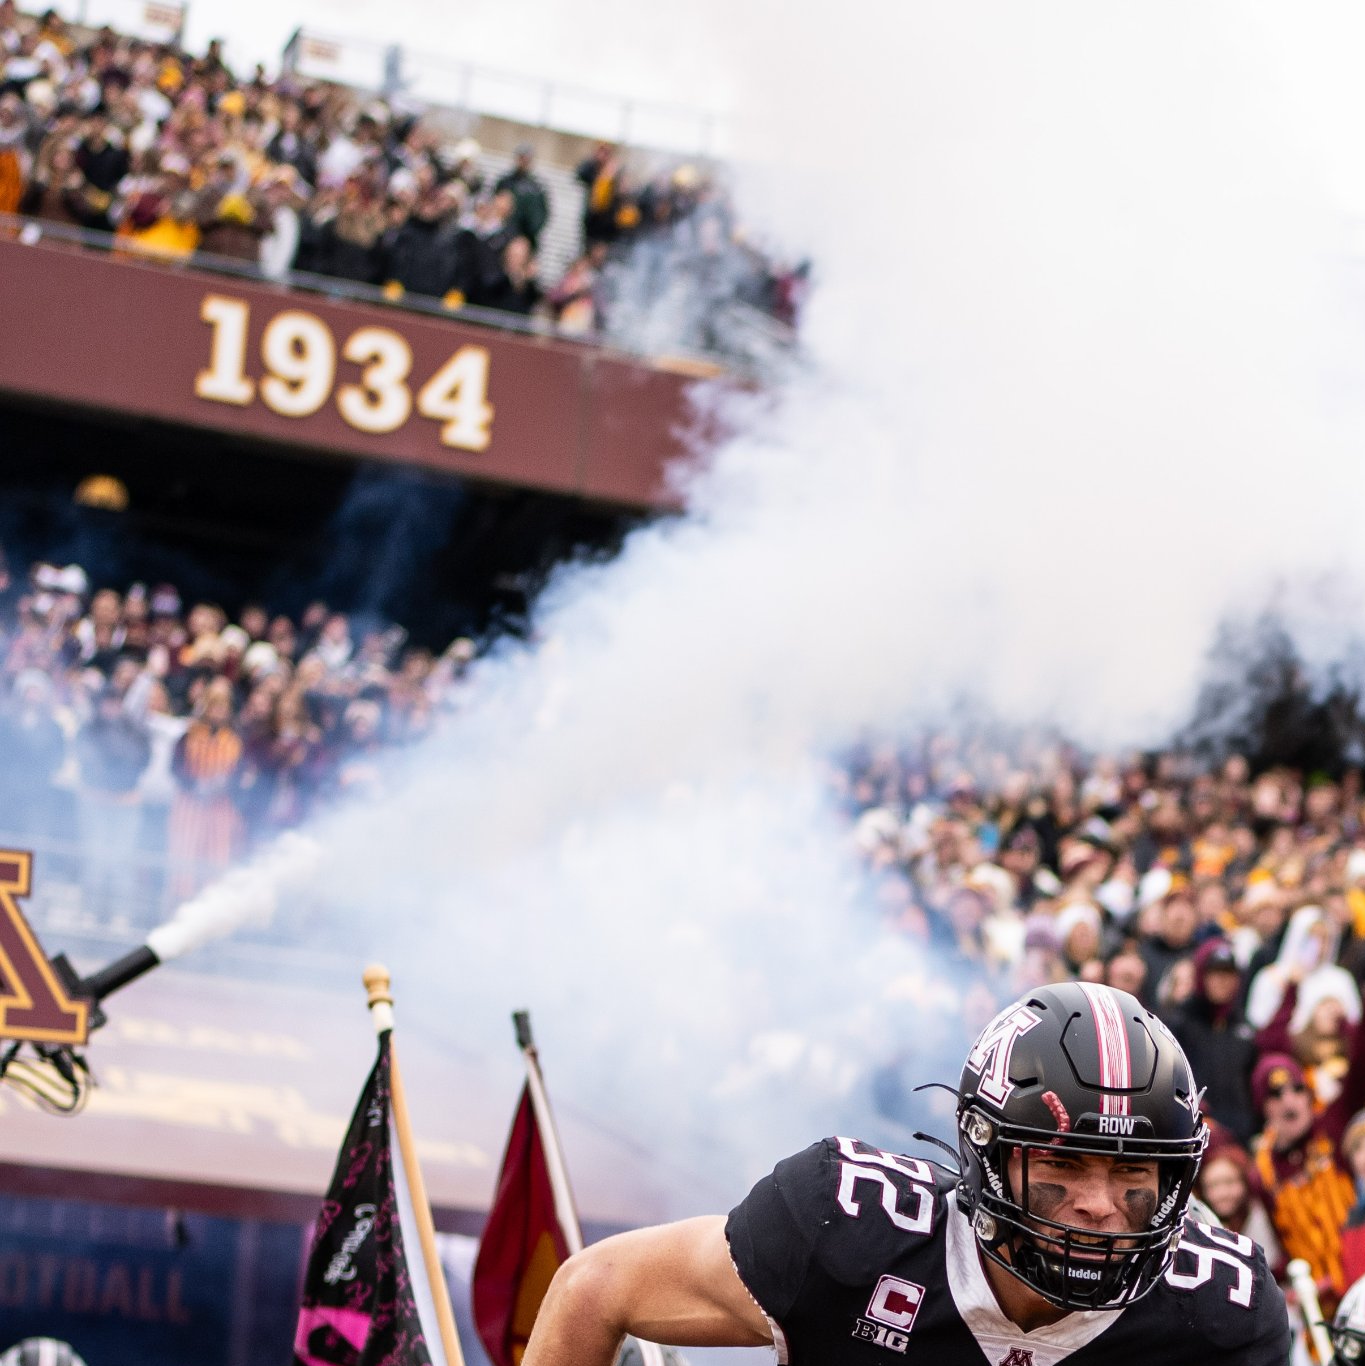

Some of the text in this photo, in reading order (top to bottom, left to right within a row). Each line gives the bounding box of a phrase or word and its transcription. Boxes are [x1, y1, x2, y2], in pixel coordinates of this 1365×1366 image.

[195, 294, 496, 452] 1934
[1099, 1116, 1136, 1136] ROW
[1067, 1265, 1102, 1282] Riddel
